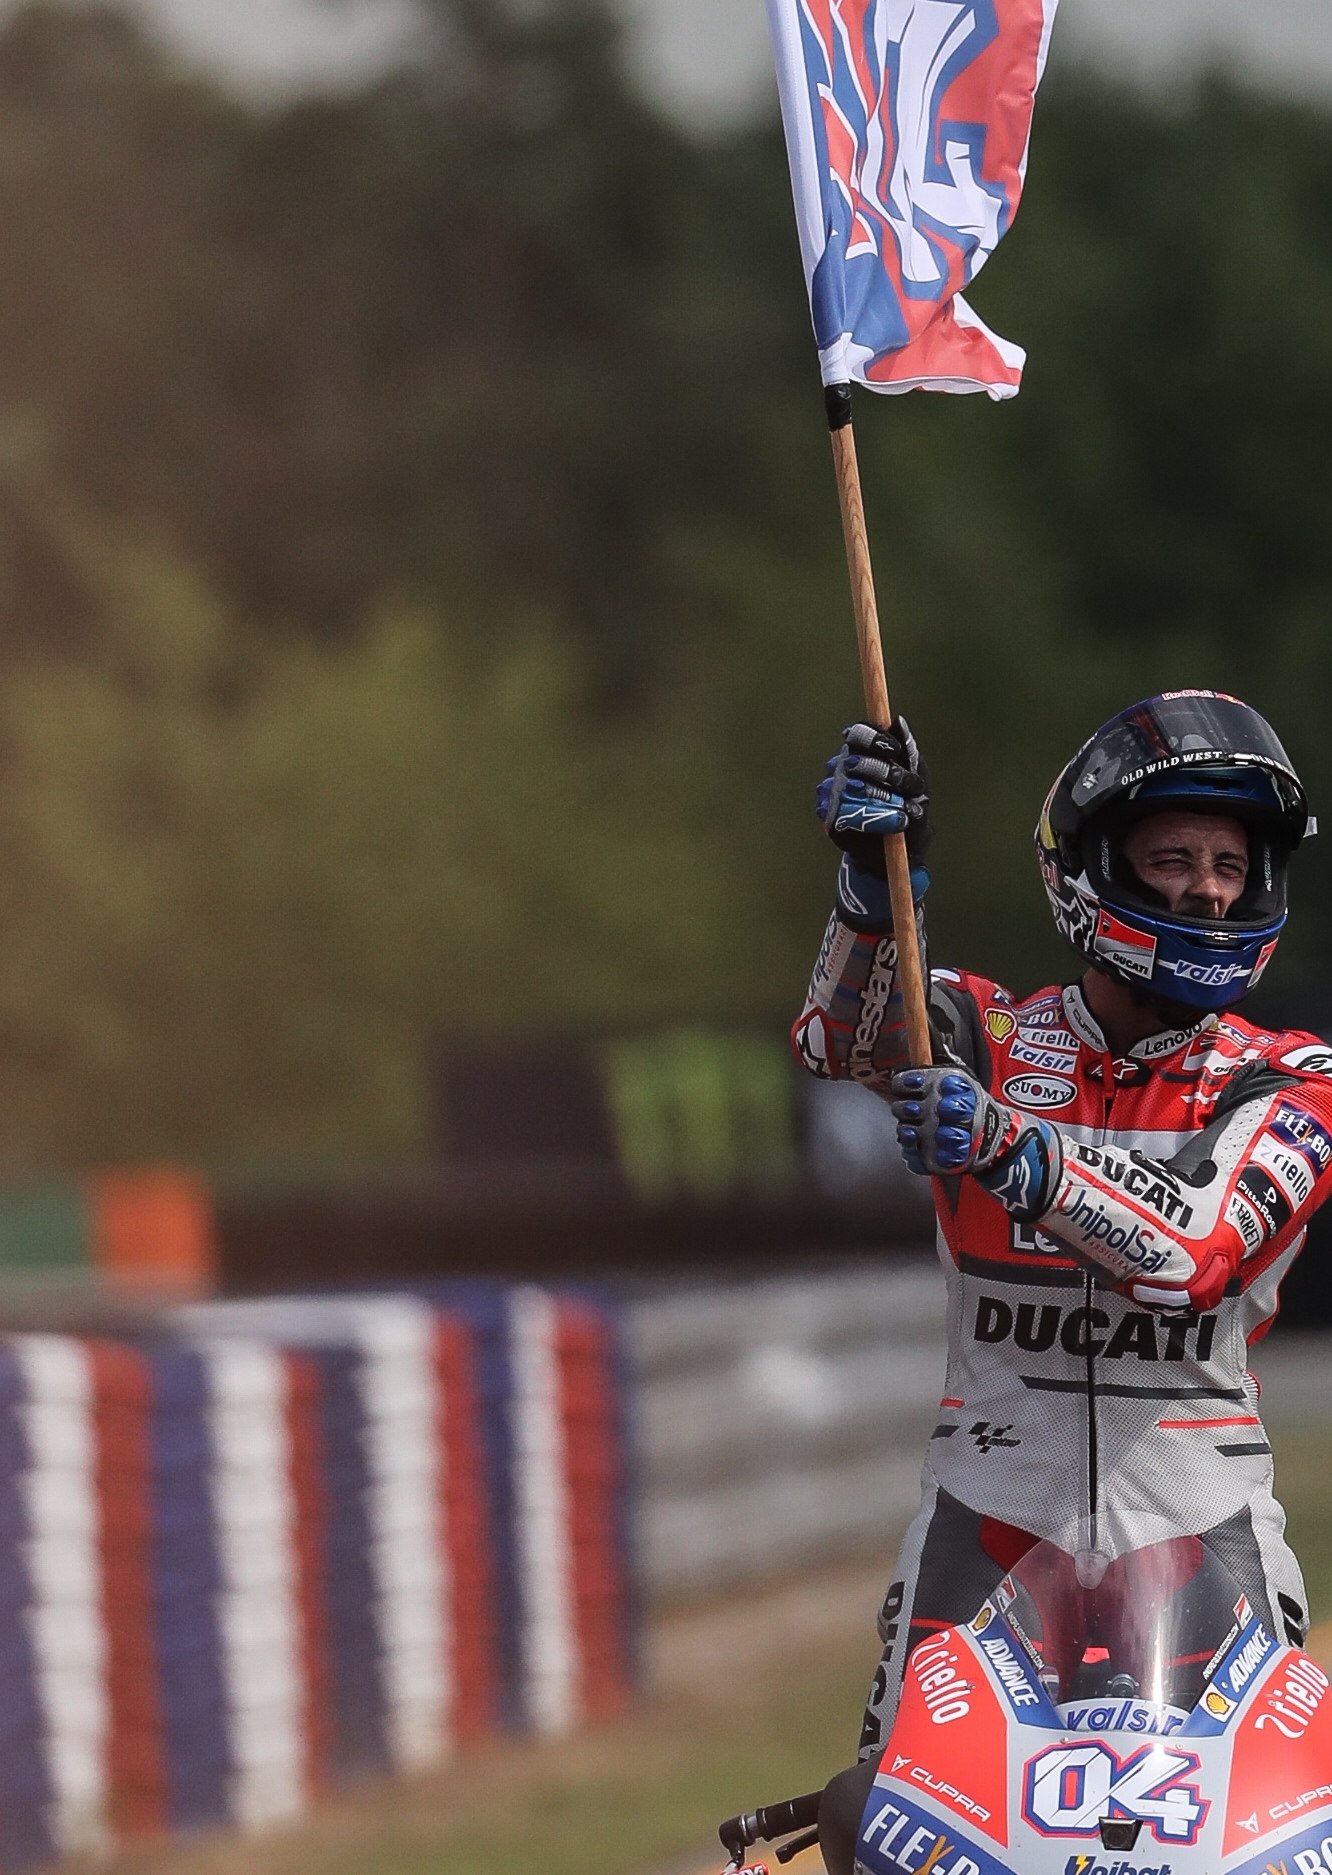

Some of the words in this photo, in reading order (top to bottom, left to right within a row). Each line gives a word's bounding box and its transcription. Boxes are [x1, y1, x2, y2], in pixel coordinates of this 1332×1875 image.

[1121, 769, 1144, 785] OLD
[1146, 756, 1180, 774] WILD
[1183, 751, 1223, 763] WEST
[1112, 952, 1149, 975] DUCATI
[1175, 960, 1242, 984] valsir
[1011, 1044, 1075, 1071] valsir
[1031, 1031, 1079, 1048] riello
[1144, 1023, 1202, 1056] Lenovo
[1011, 1080, 1071, 1101] SUOMY
[1077, 1145, 1194, 1229] DUCATI
[1273, 1153, 1308, 1203] riello
[1057, 1180, 1173, 1274] UnipolSai
[974, 1295, 1218, 1362] DUCATI
[858, 1581, 906, 1765] DUCA
[914, 1649, 970, 1725] riello
[981, 1638, 1040, 1707] ADVANCE
[1229, 1622, 1272, 1694] ADVANCE
[1067, 1701, 1184, 1736] valsir
[1274, 1658, 1330, 1727] riello
[909, 1765, 993, 1823] CUPRA
[1024, 1740, 1209, 1843] 04
